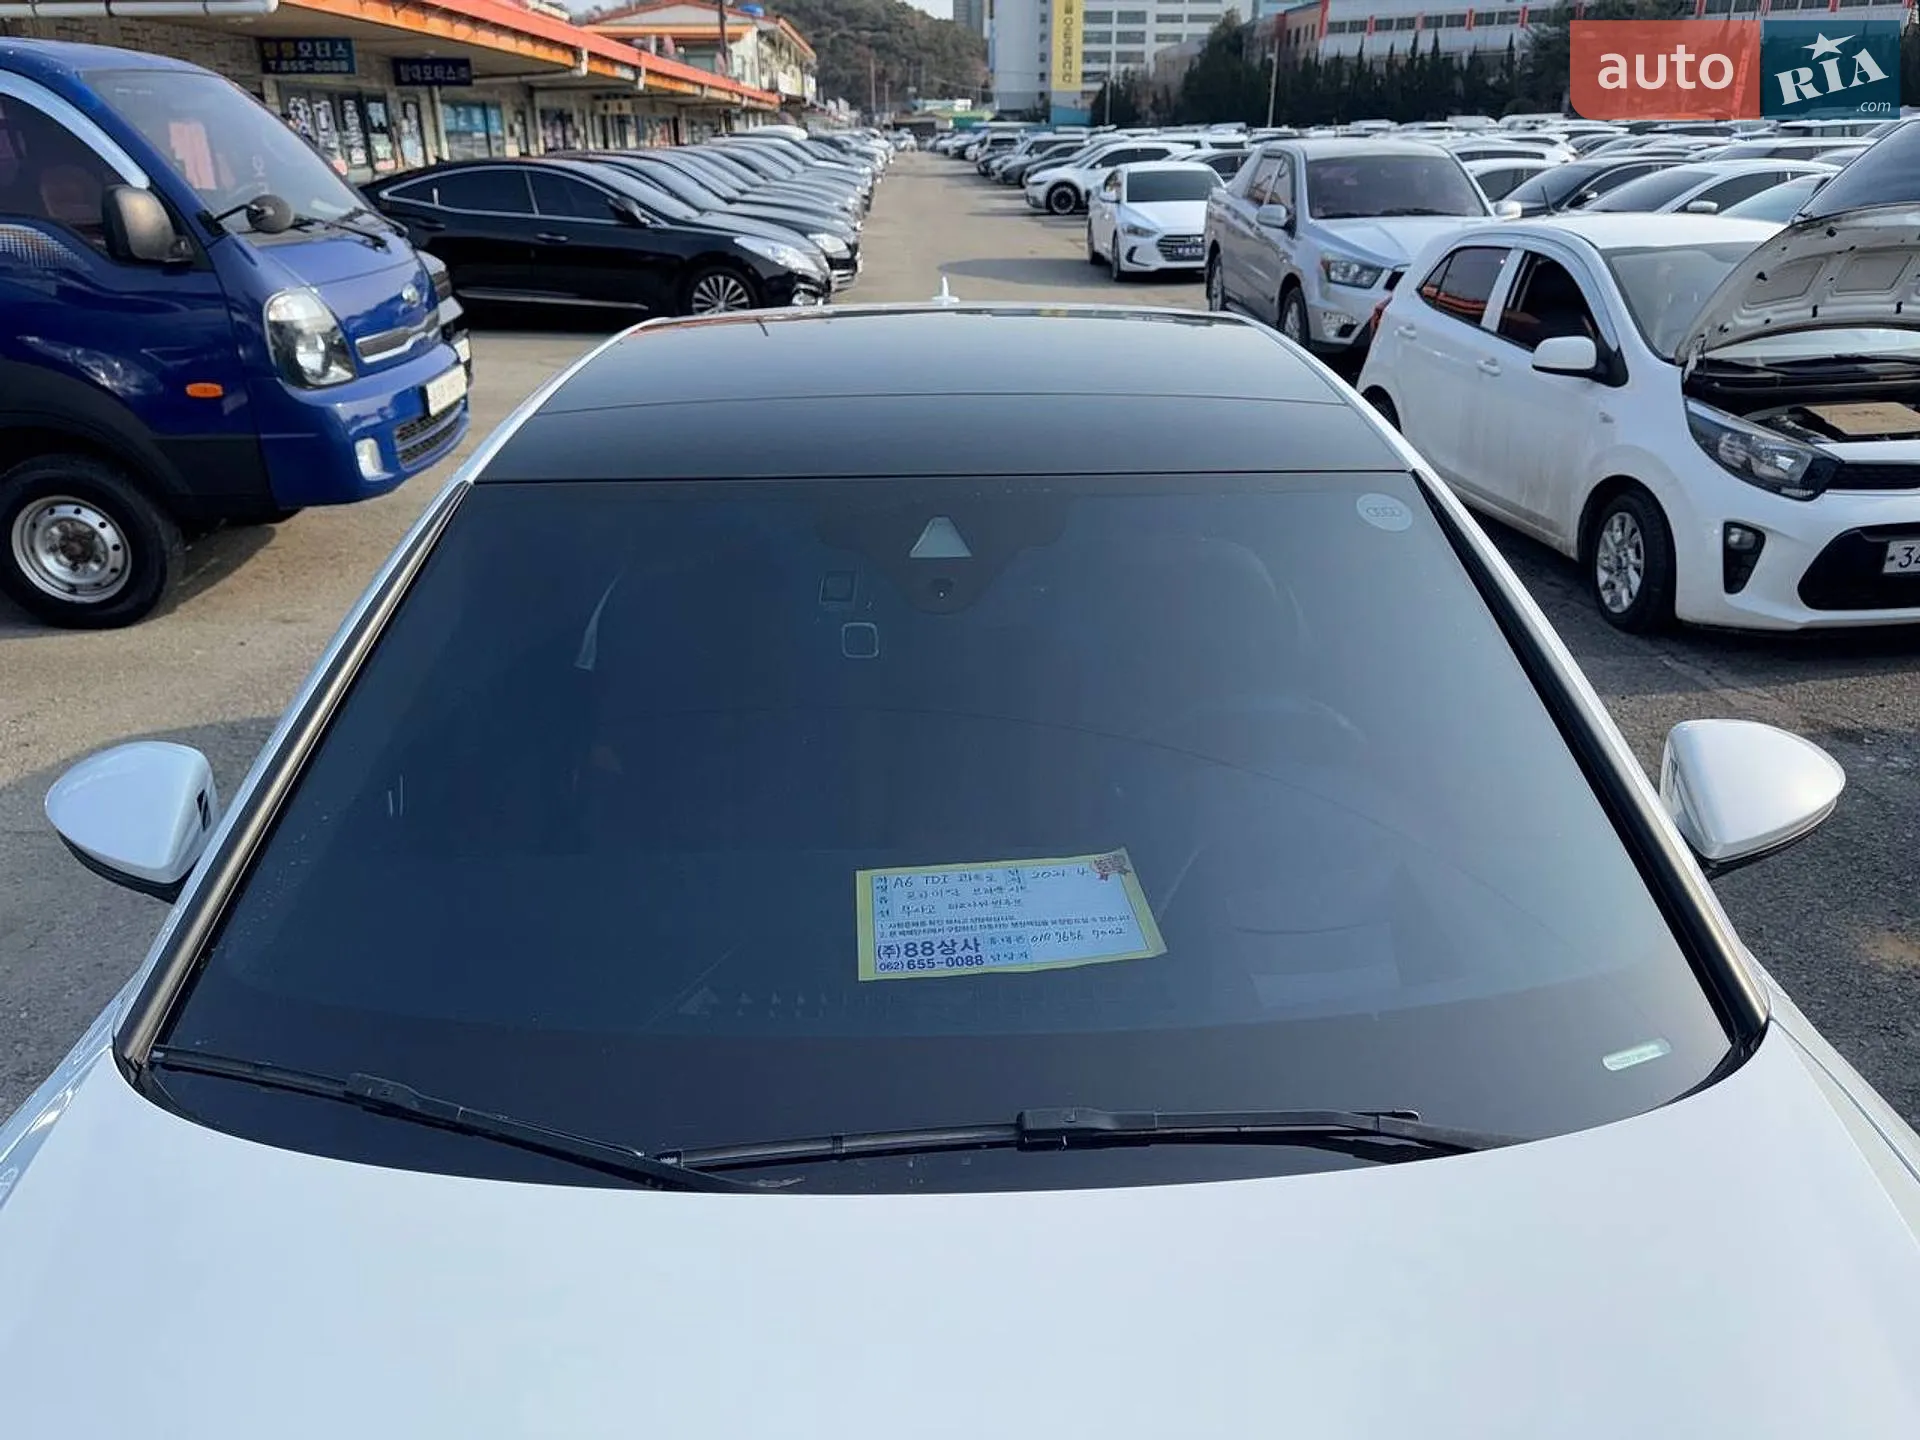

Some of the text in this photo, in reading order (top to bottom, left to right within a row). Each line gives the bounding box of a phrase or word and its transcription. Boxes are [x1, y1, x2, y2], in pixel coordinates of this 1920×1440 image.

[893, 876, 914, 888] A6
[923, 874, 950, 885] TDI
[877, 937, 982, 959] (주) 88상사
[879, 955, 985, 971] 062) 655-0088
